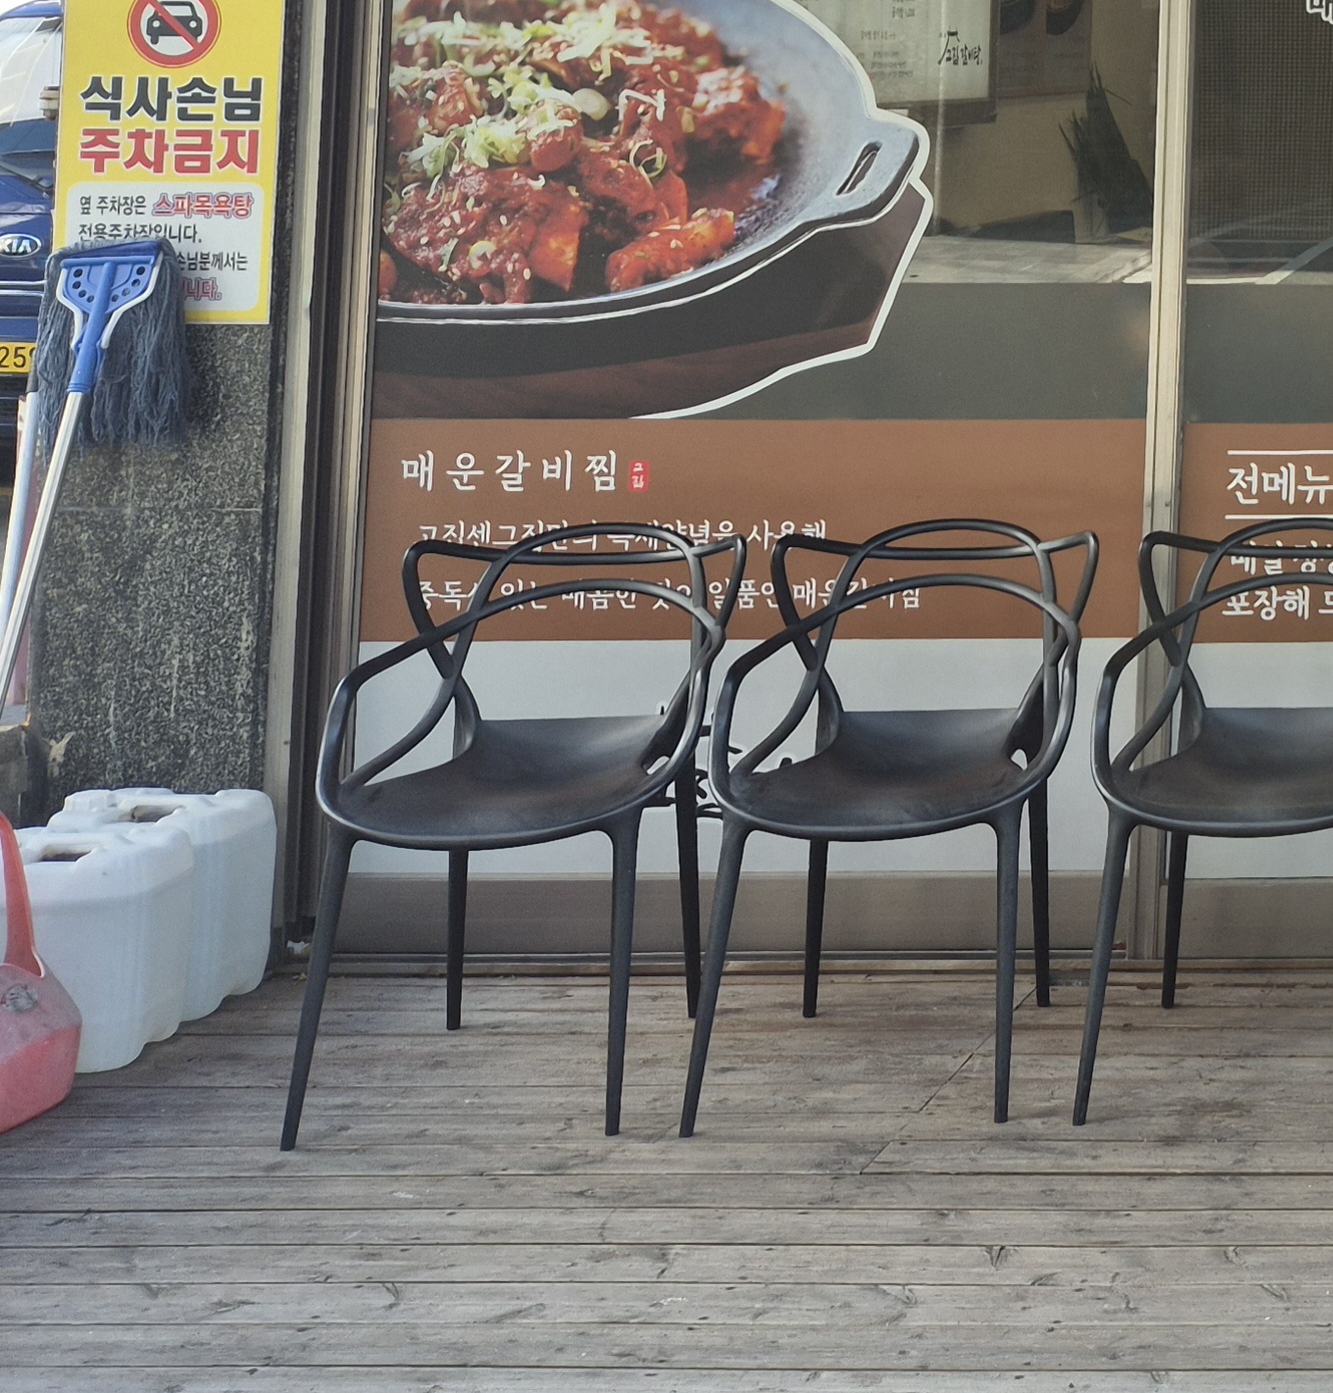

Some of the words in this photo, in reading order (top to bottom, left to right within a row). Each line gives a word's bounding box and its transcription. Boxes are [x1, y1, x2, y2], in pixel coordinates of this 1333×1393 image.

[79, 74, 262, 122] 식사손님
[78, 128, 260, 176] 주차금지
[79, 195, 92, 215] 옆
[96, 195, 146, 216] 주차장은
[151, 192, 255, 219] 스파목욕탕
[0, 239, 33, 254] KIA
[183, 278, 222, 301] 니다.
[1221, 585, 1311, 621] 포장해
